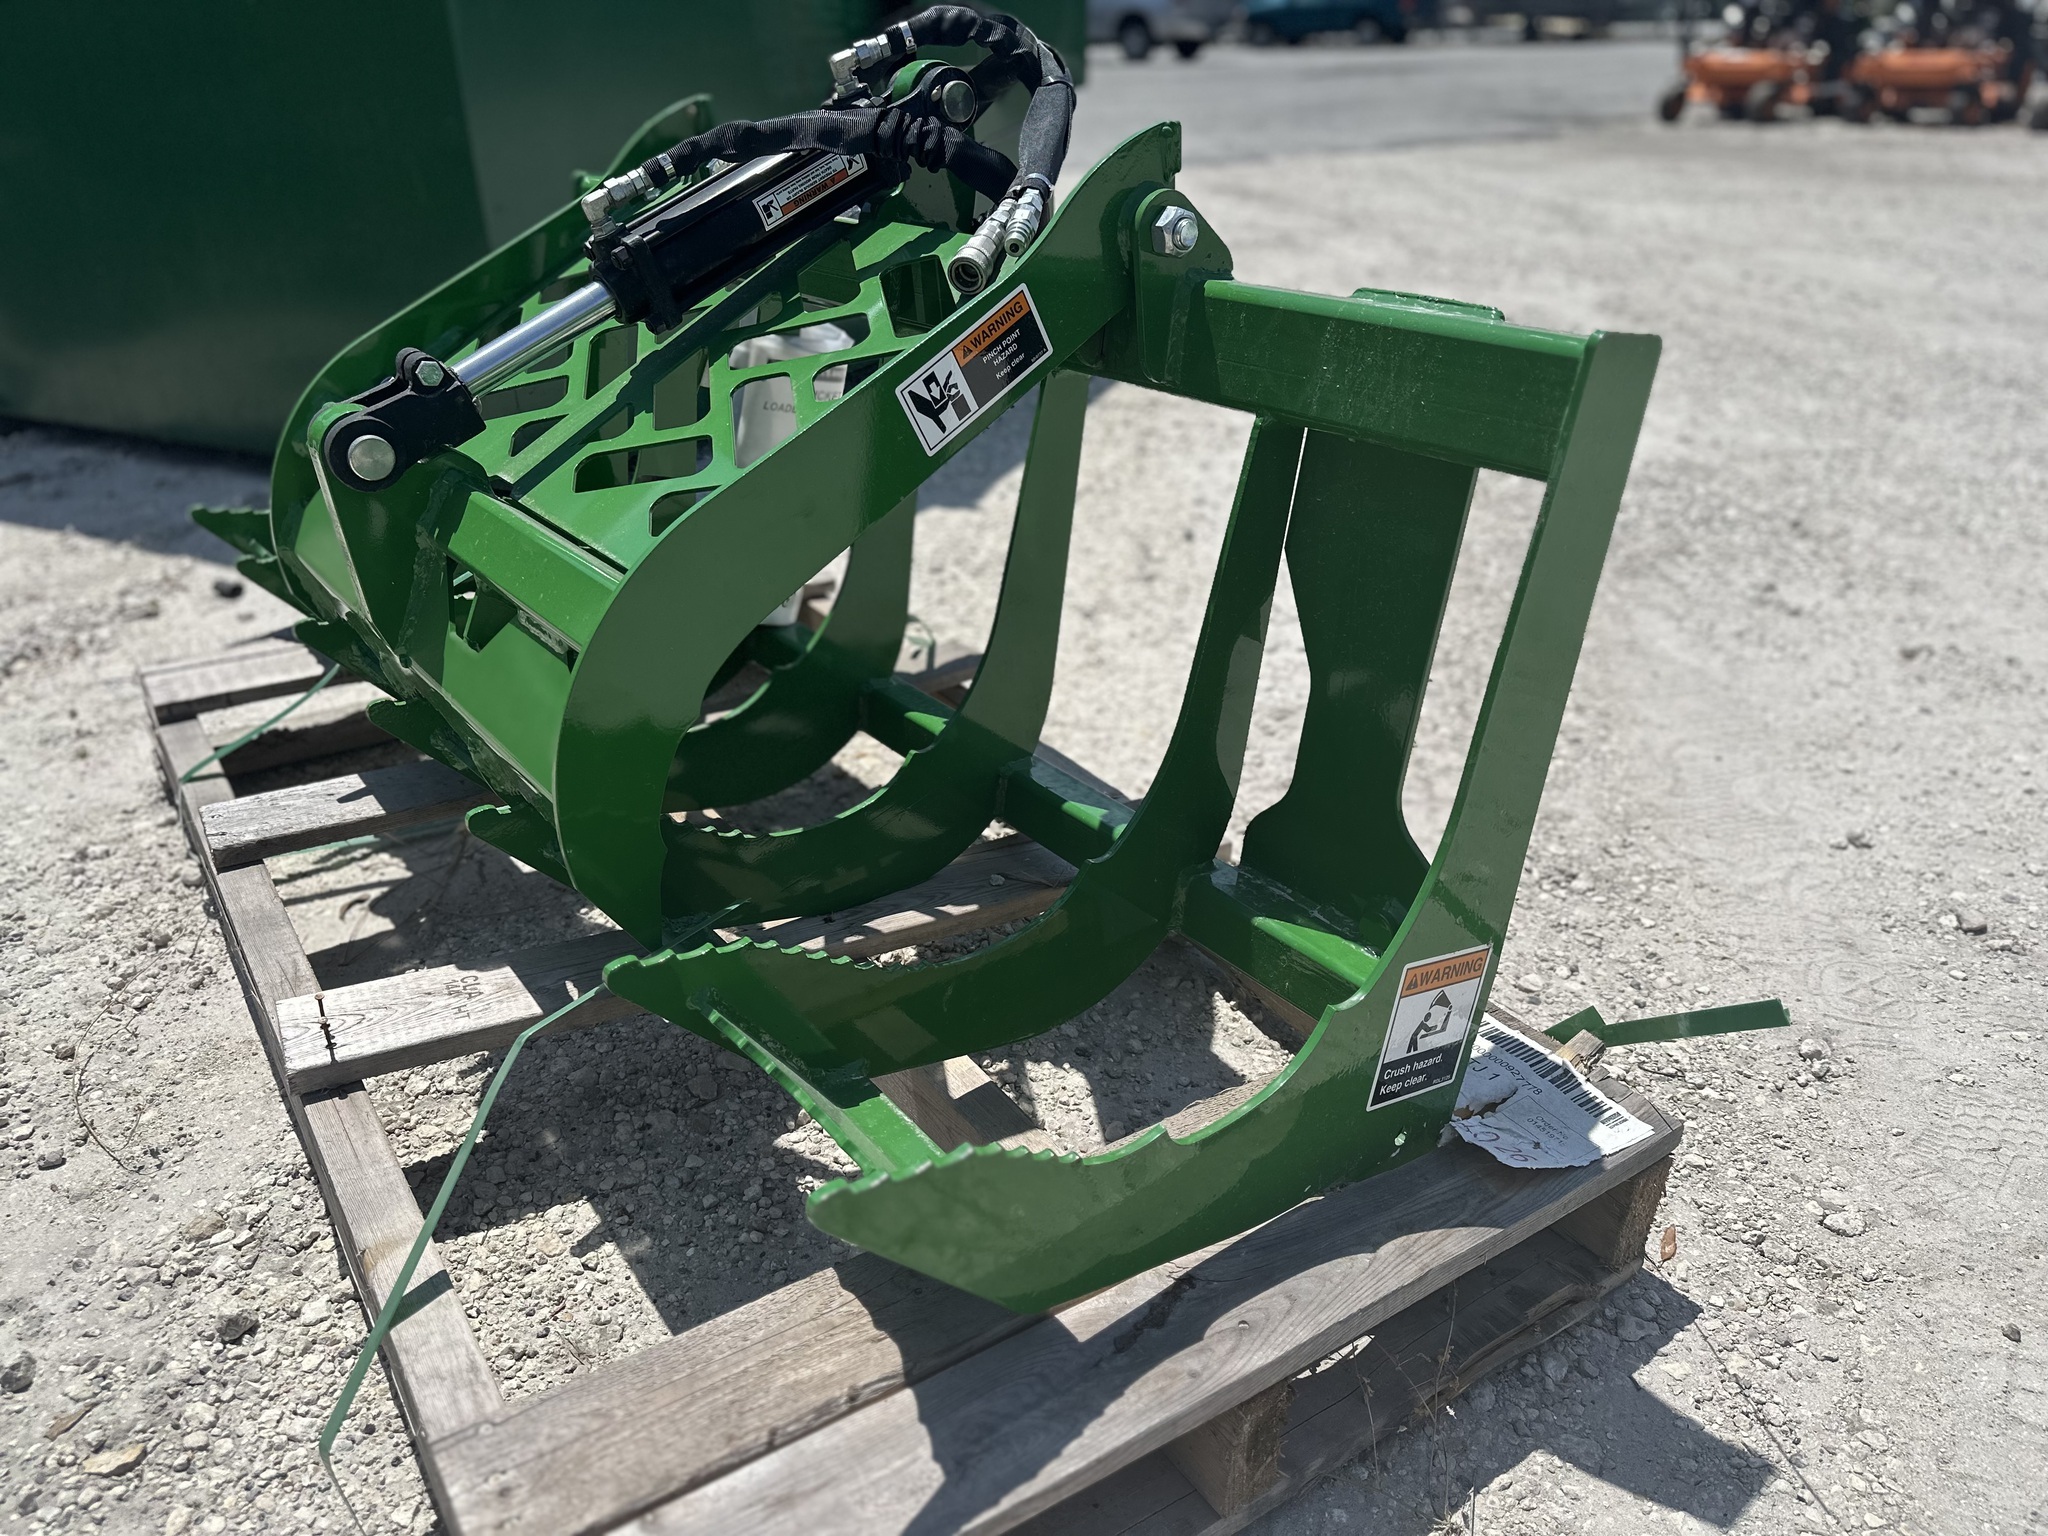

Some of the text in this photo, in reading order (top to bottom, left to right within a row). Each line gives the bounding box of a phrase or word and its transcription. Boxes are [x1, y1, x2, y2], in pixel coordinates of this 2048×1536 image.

[793, 182, 828, 206] WARNING
[970, 301, 1024, 349] WARNING
[982, 328, 1021, 364] PINCH POINT
[992, 342, 1018, 366] HAZARD
[995, 364, 1011, 380] Keep
[1011, 352, 1026, 367] clear
[1419, 957, 1484, 987] WARNING
[1384, 1053, 1443, 1080] Crush hazard.
[1379, 1073, 1428, 1096] Keep clear.
[1535, 1115, 1558, 1133] Order
